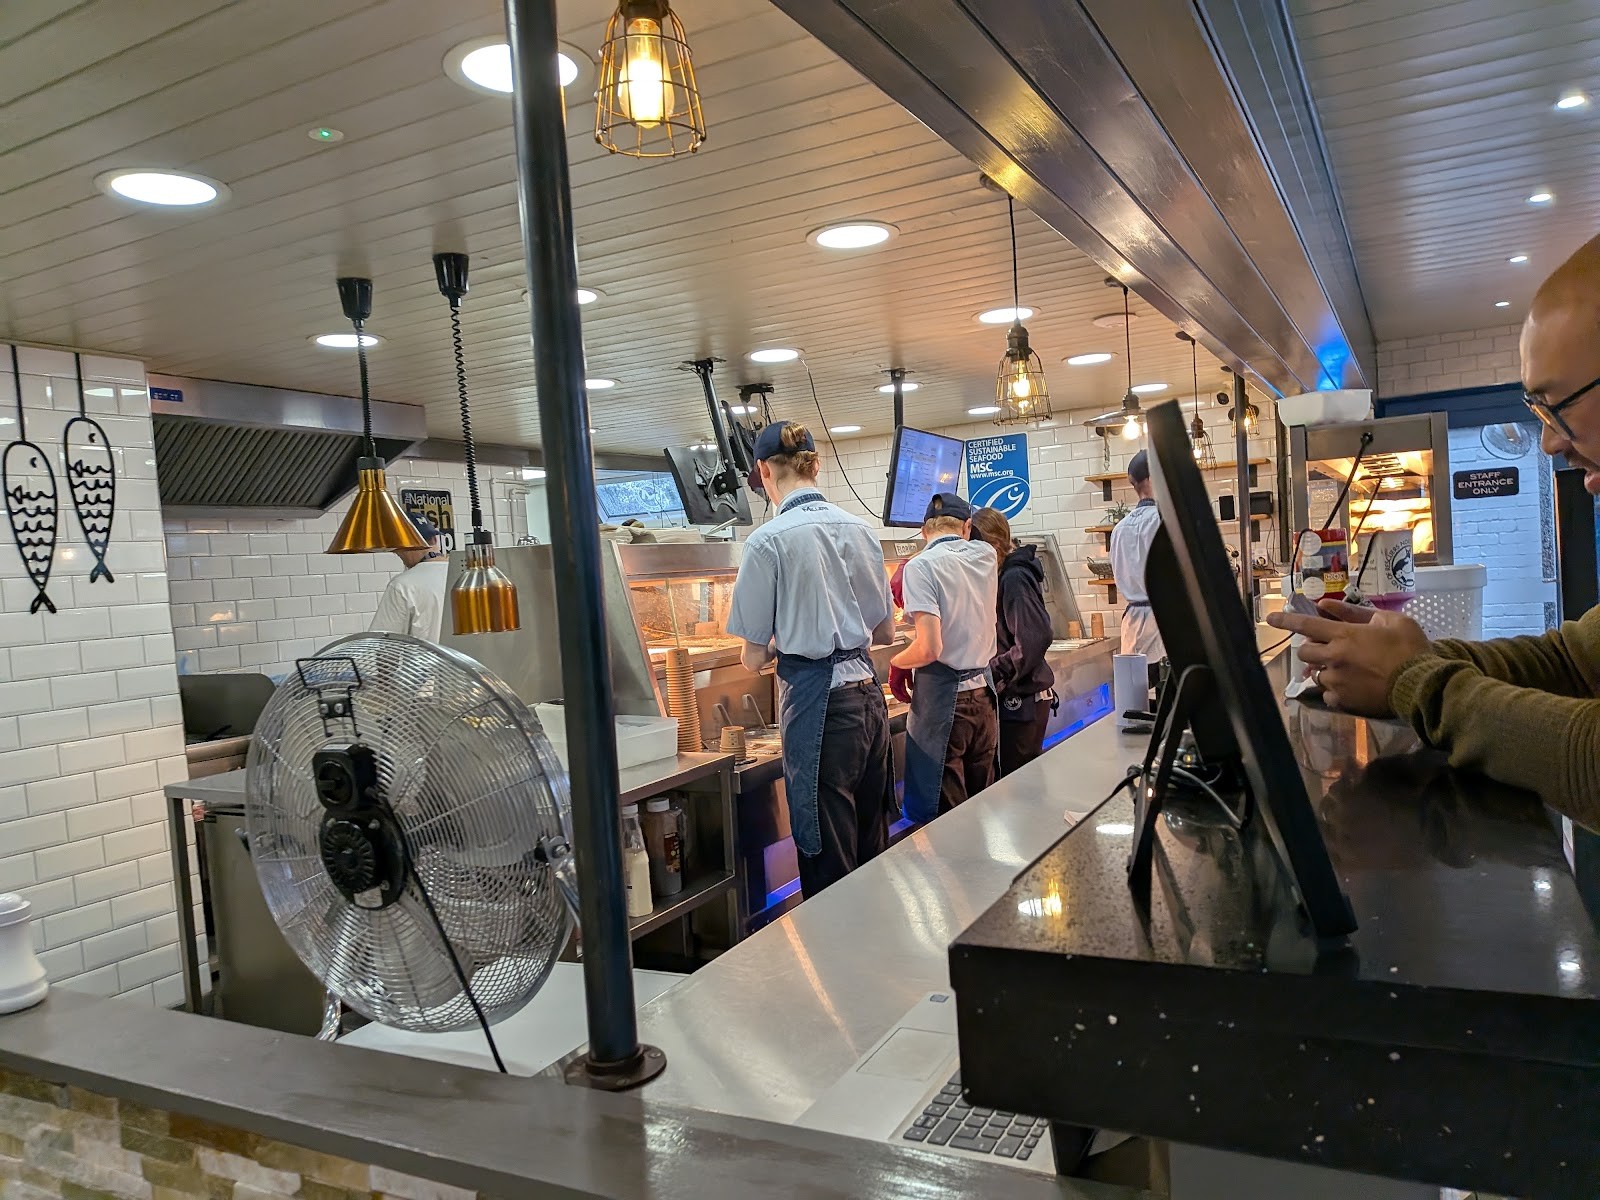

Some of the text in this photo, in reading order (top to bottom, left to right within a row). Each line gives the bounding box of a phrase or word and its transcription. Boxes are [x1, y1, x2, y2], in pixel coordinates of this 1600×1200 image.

[968, 438, 1004, 449] CERTIFIED
[968, 444, 1017, 456] SUSTAINABLE
[969, 453, 1004, 463] SEAFOOD
[970, 462, 993, 474] MSC
[970, 469, 1014, 479] www.msc.org
[1470, 471, 1501, 480] STAFF
[1458, 478, 1514, 489] ENTRANCE
[1472, 487, 1500, 495] ONLY
[409, 492, 449, 506] National
